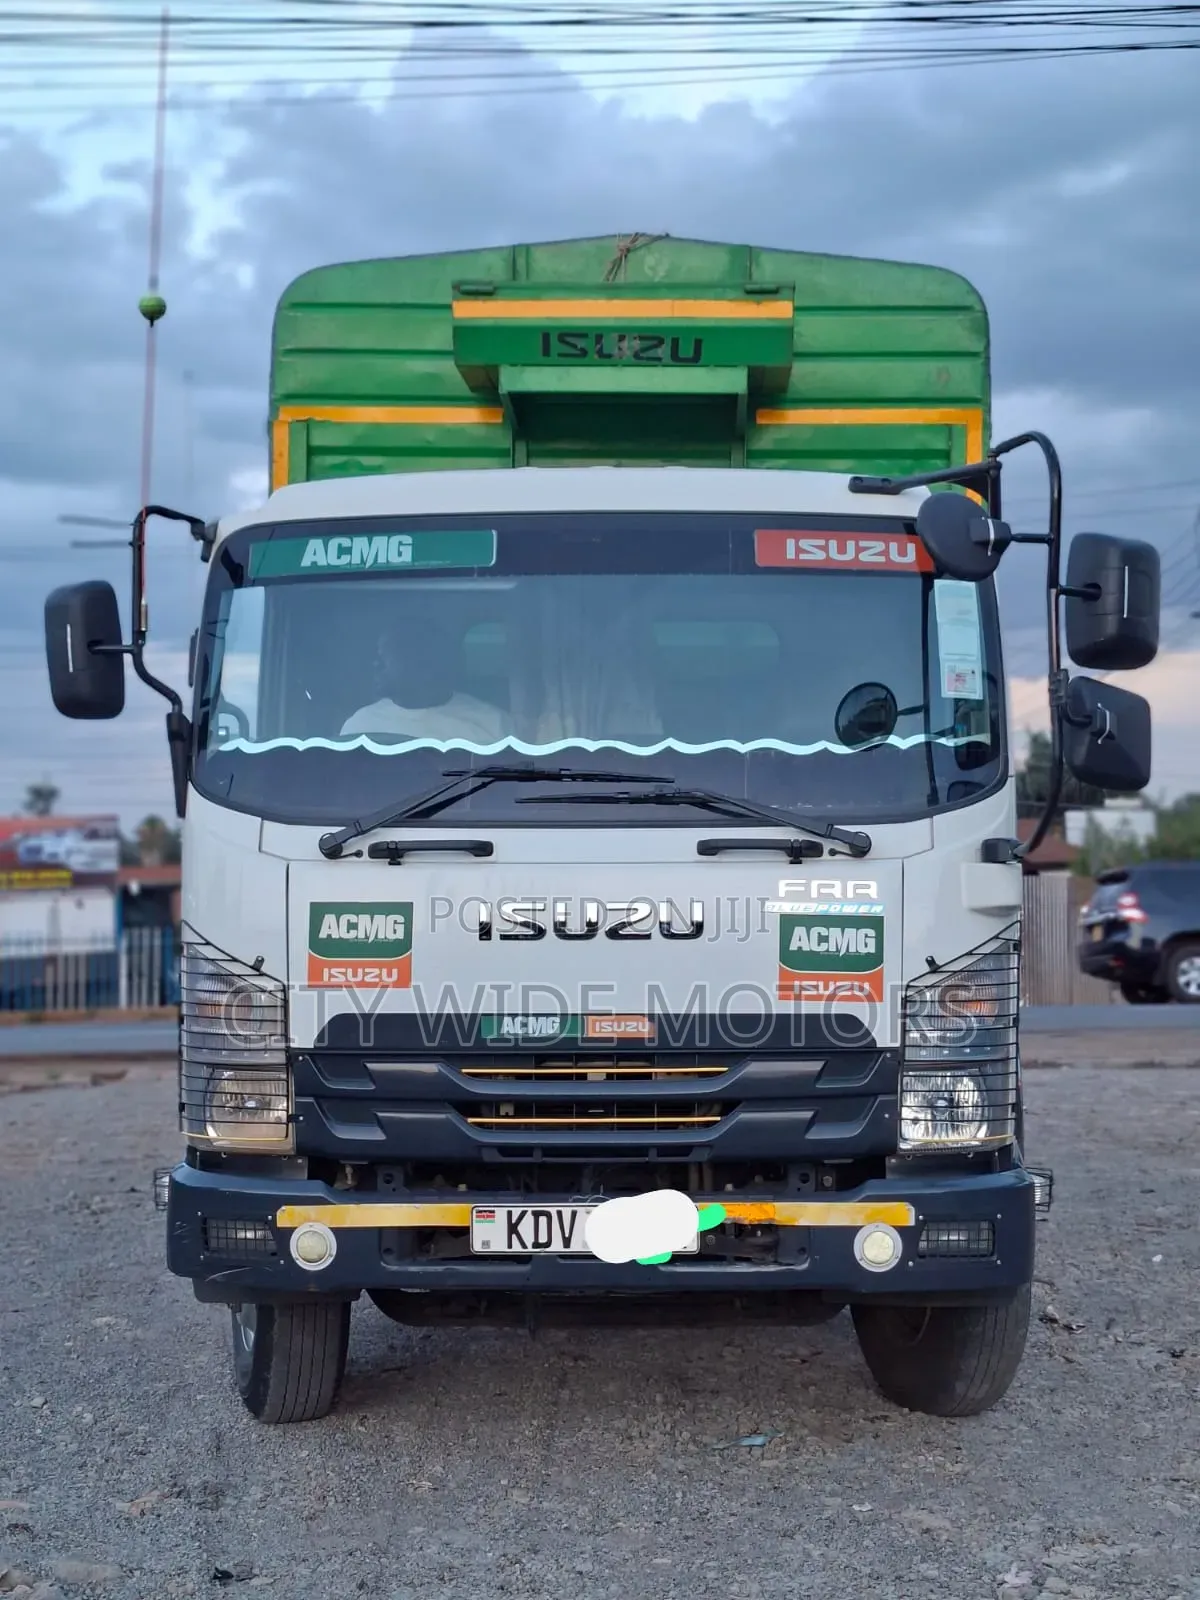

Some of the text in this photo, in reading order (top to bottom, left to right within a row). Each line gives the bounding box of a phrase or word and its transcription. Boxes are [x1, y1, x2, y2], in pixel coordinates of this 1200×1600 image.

[541, 332, 704, 364] ISUZU
[300, 534, 413, 569] ACMG
[786, 538, 916, 564] ISUZU
[318, 913, 405, 943] ACMG
[478, 901, 704, 941] ISUZU
[789, 926, 876, 957] ACMG
[322, 967, 399, 983] ISUZU
[793, 980, 870, 996] ISUZU
[501, 1016, 561, 1037] ACMG
[595, 1021, 651, 1033] ISUZU
[506, 1209, 578, 1250] KDV
